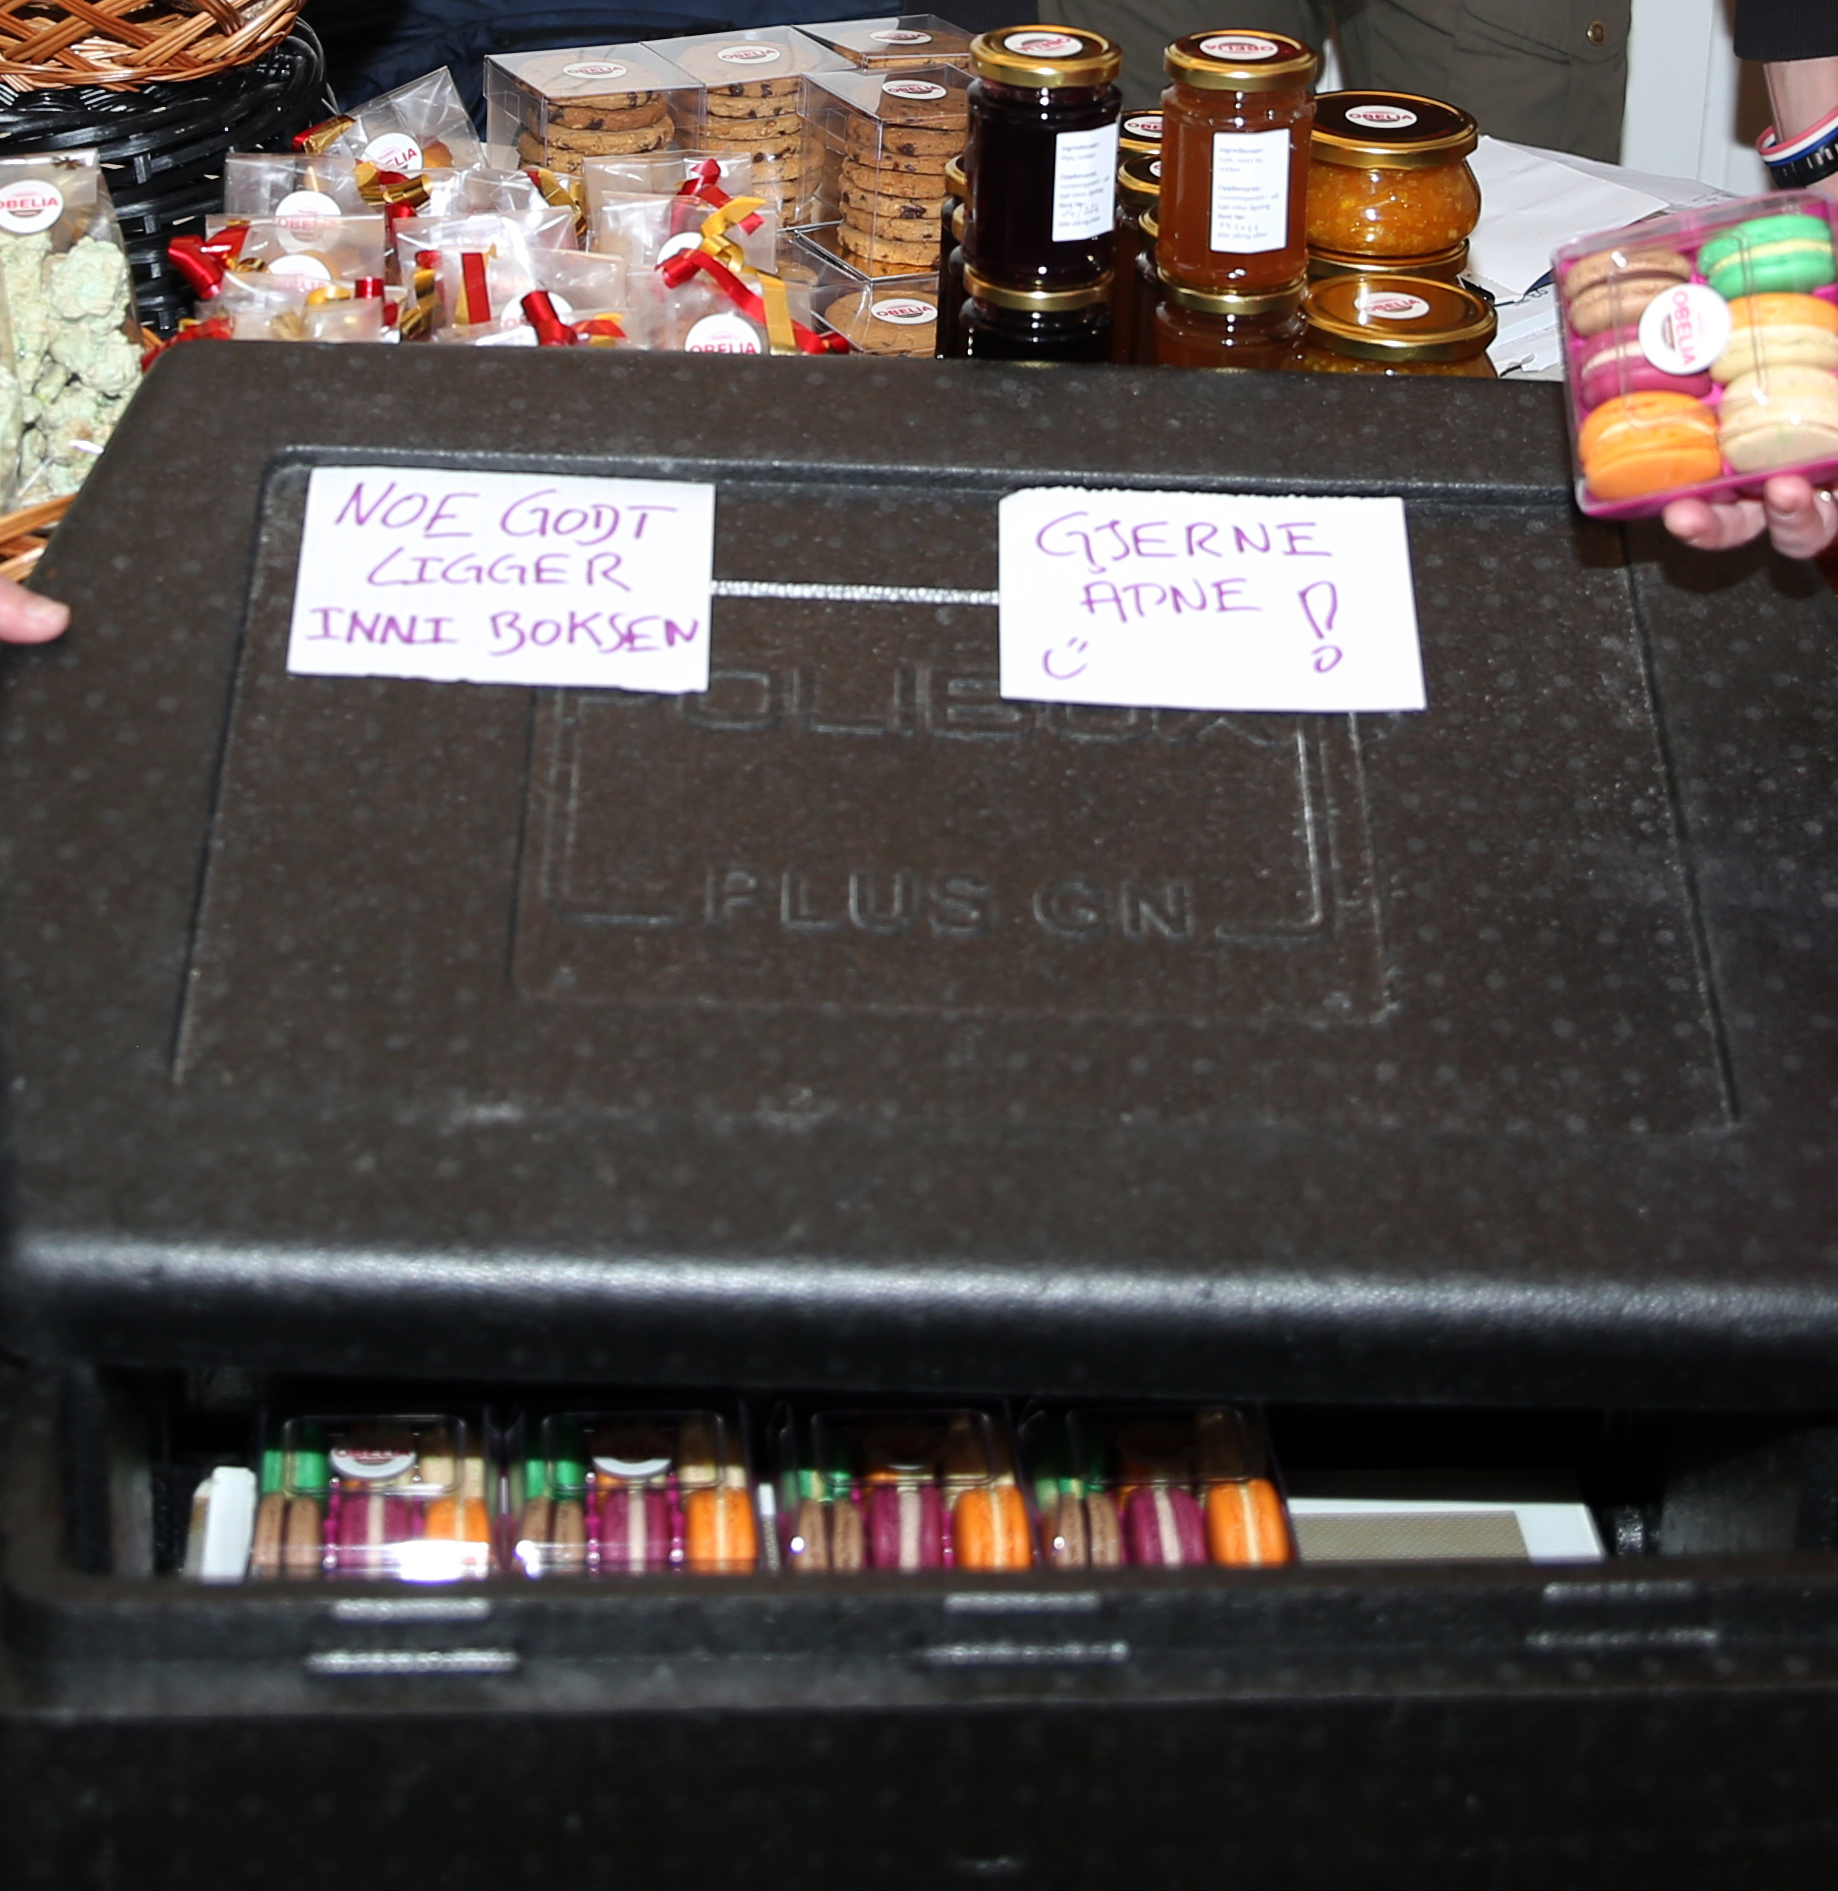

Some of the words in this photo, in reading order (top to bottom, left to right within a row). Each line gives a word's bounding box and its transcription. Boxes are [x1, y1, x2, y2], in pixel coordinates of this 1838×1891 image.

[1348, 112, 1414, 121] OBELIA
[876, 305, 934, 316] OBELIA
[1365, 298, 1422, 312] BELIA
[1673, 291, 1698, 366] OBELIA
[334, 481, 480, 539] NOE
[499, 489, 678, 546] GODT
[1035, 511, 1334, 567] GJERNE
[366, 546, 632, 592] LIGGER
[305, 606, 460, 646] INNI
[488, 608, 700, 657] BOKSEN
[705, 866, 993, 939] PLUS
